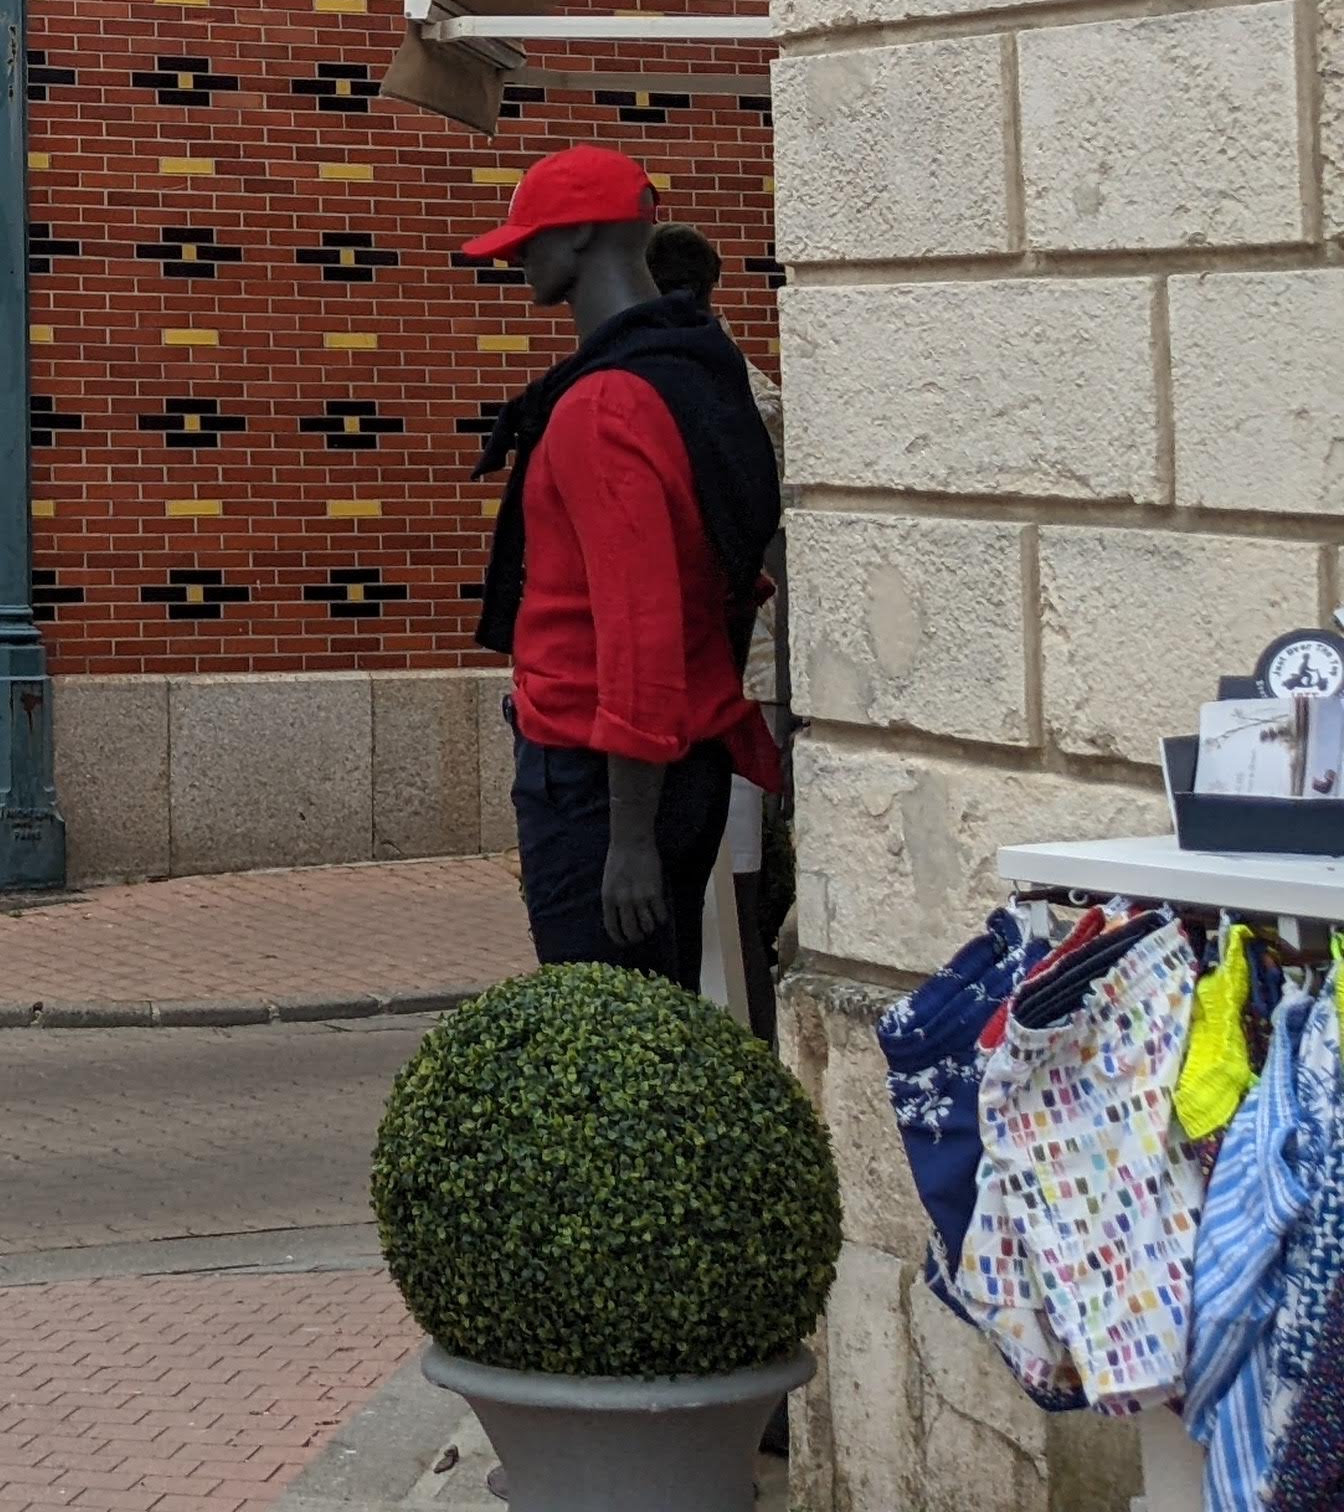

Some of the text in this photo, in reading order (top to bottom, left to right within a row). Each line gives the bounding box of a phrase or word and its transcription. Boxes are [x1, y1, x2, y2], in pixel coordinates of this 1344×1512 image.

[1271, 656, 1287, 677] Just
[1286, 643, 1312, 657] Over
[1315, 643, 1333, 658] The
